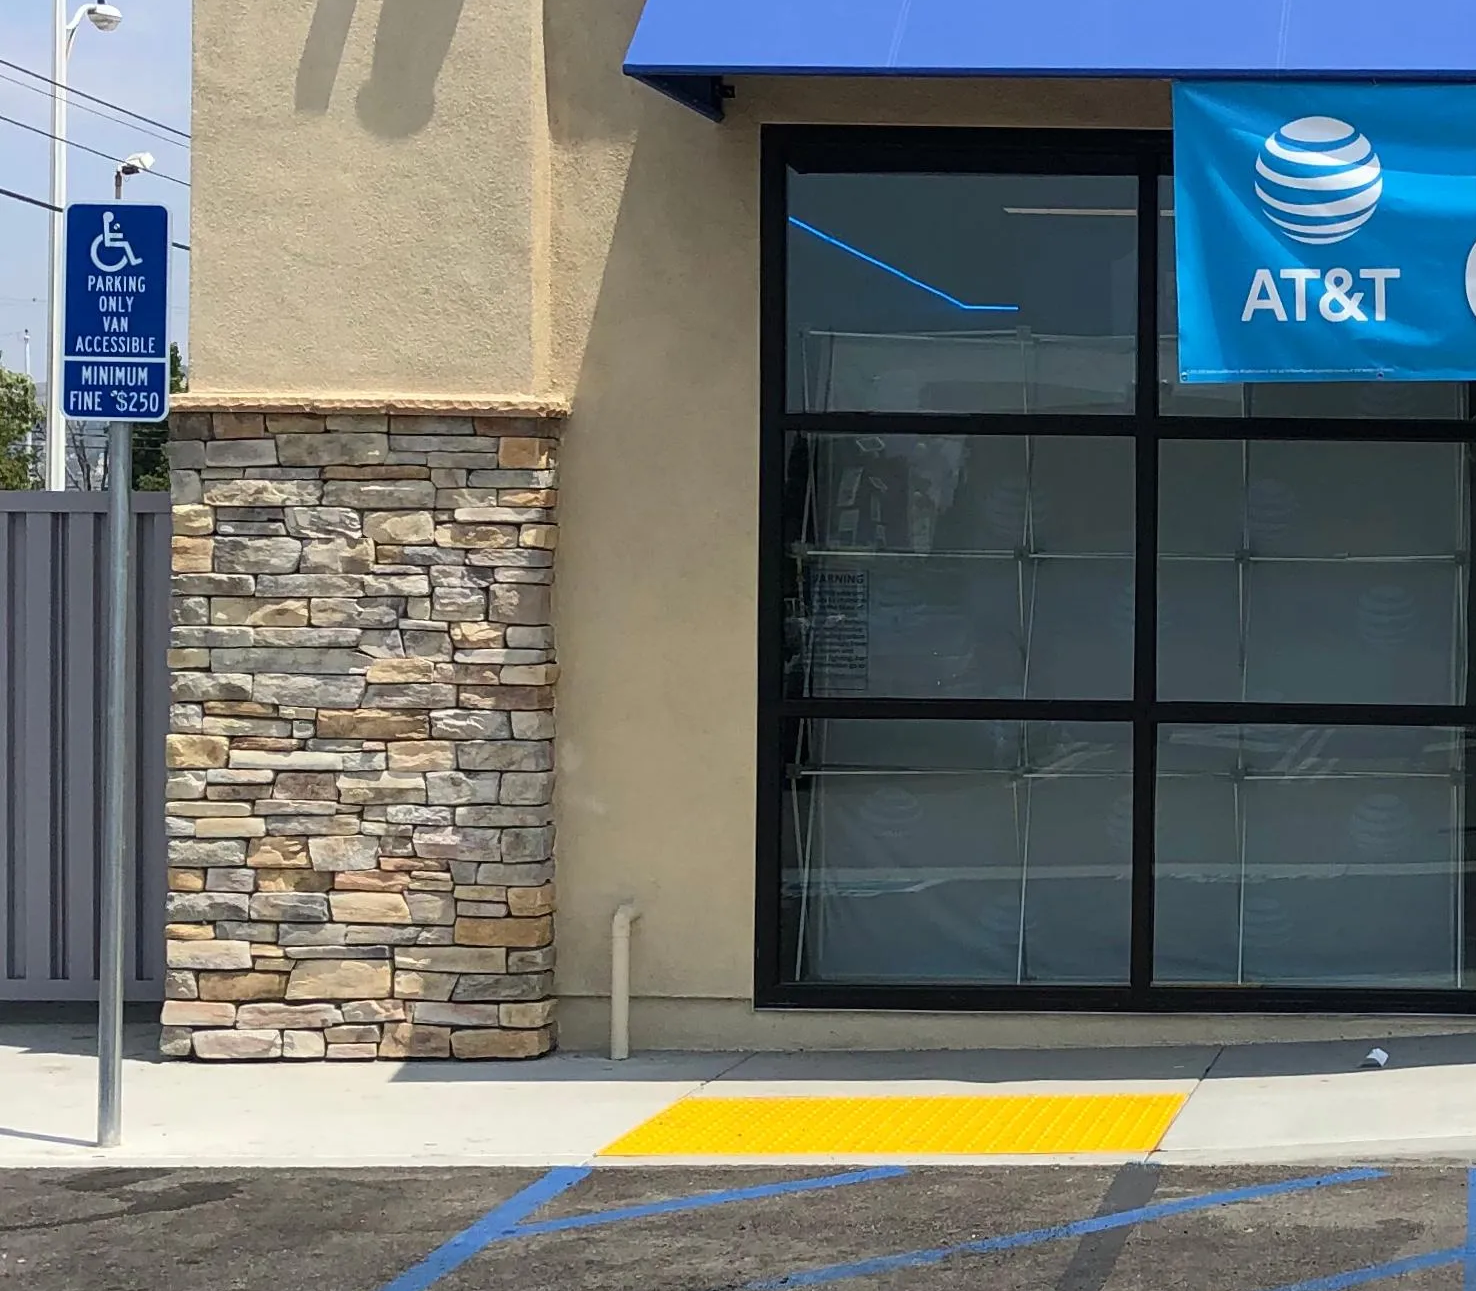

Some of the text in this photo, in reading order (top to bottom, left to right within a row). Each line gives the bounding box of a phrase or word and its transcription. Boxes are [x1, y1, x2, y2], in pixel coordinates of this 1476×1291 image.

[87, 275, 146, 293] PARKING
[98, 295, 134, 313] ONLY
[1241, 267, 1401, 322] AT&T
[103, 316, 128, 333] VAN
[75, 335, 156, 354] ACCESSIBLE
[81, 365, 148, 386] MINIMUM
[69, 390, 159, 413] FINE $250
